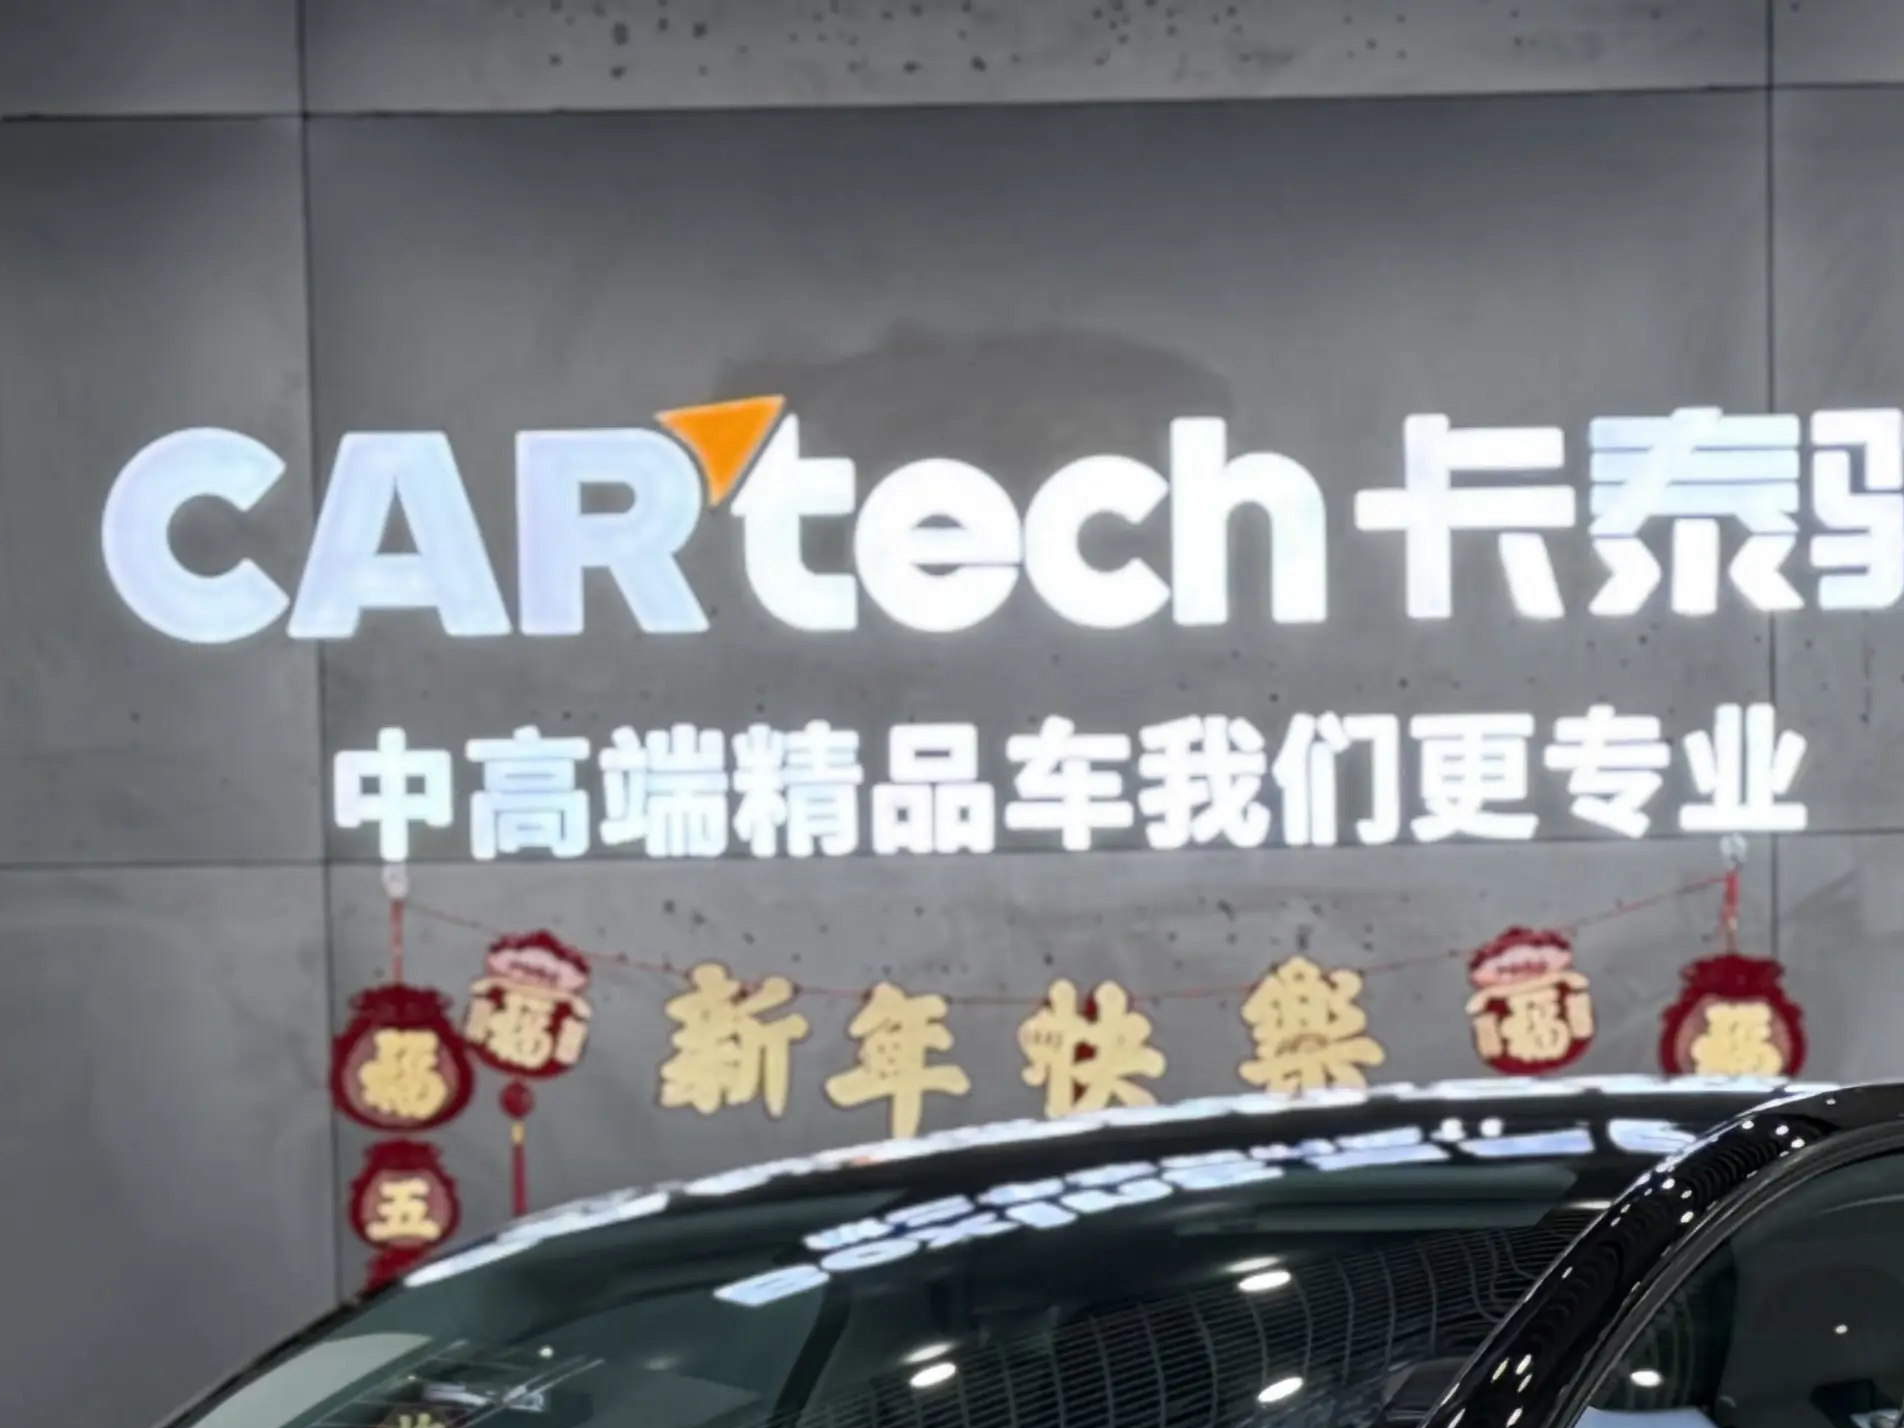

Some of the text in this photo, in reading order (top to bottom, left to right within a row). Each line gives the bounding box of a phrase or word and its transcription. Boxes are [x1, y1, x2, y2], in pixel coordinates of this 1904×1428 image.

[101, 411, 1328, 643] CARtech
[332, 703, 1809, 862] 中高端精品车我们更专业
